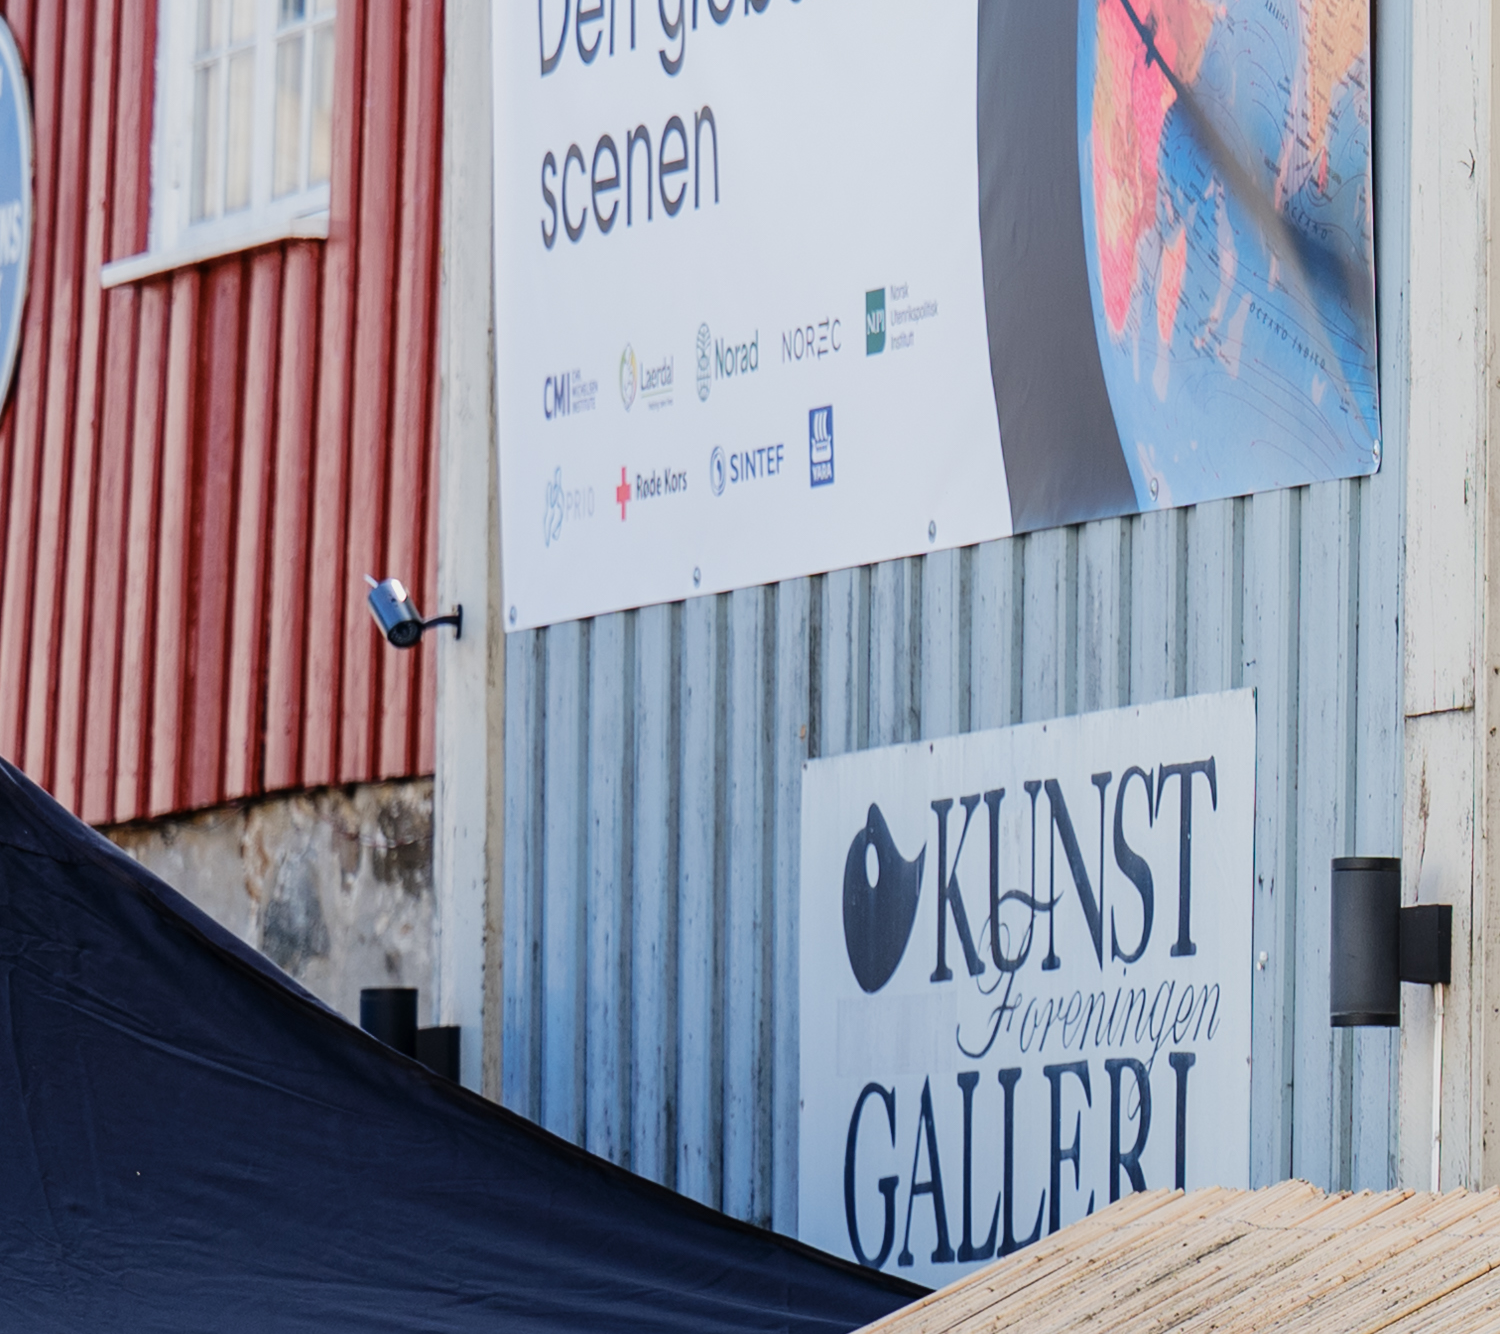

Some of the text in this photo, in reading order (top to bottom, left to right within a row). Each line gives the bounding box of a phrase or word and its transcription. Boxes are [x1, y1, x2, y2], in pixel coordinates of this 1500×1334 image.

[540, 104, 721, 252] scenen
[640, 355, 674, 391] Laerdal
[715, 329, 759, 380] Norad
[544, 372, 571, 421] CMI
[636, 468, 688, 501] Røde Kors
[730, 444, 785, 483] SINTEF
[566, 487, 595, 522] PRIO
[930, 755, 1218, 983] KUNST
[957, 889, 1222, 1121] Foreningen
[843, 1052, 1197, 1271] GALLERI
